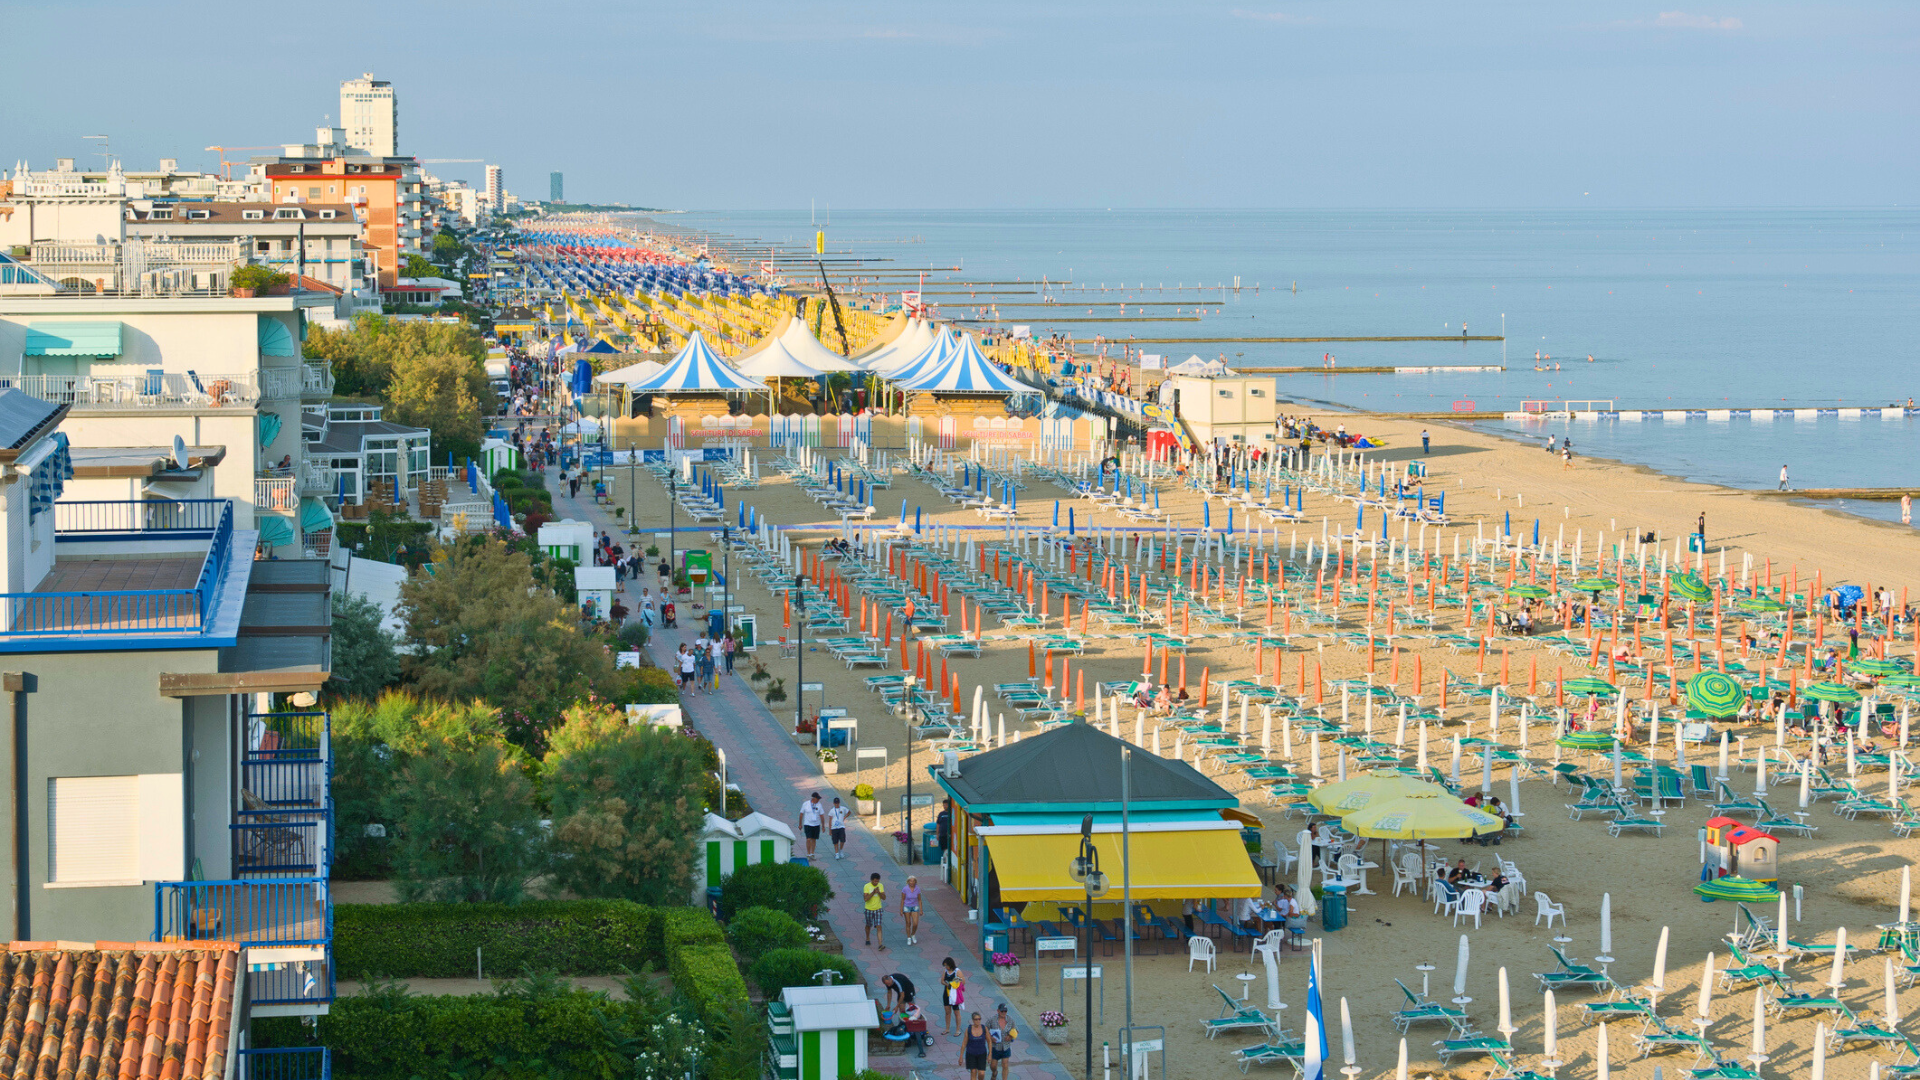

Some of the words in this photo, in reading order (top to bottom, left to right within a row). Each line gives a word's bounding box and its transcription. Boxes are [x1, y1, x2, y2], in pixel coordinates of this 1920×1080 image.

[728, 429, 736, 437] DI
[737, 429, 763, 437] SABBIA
[999, 431, 1007, 439] DI
[1008, 431, 1034, 439] SABBIA
